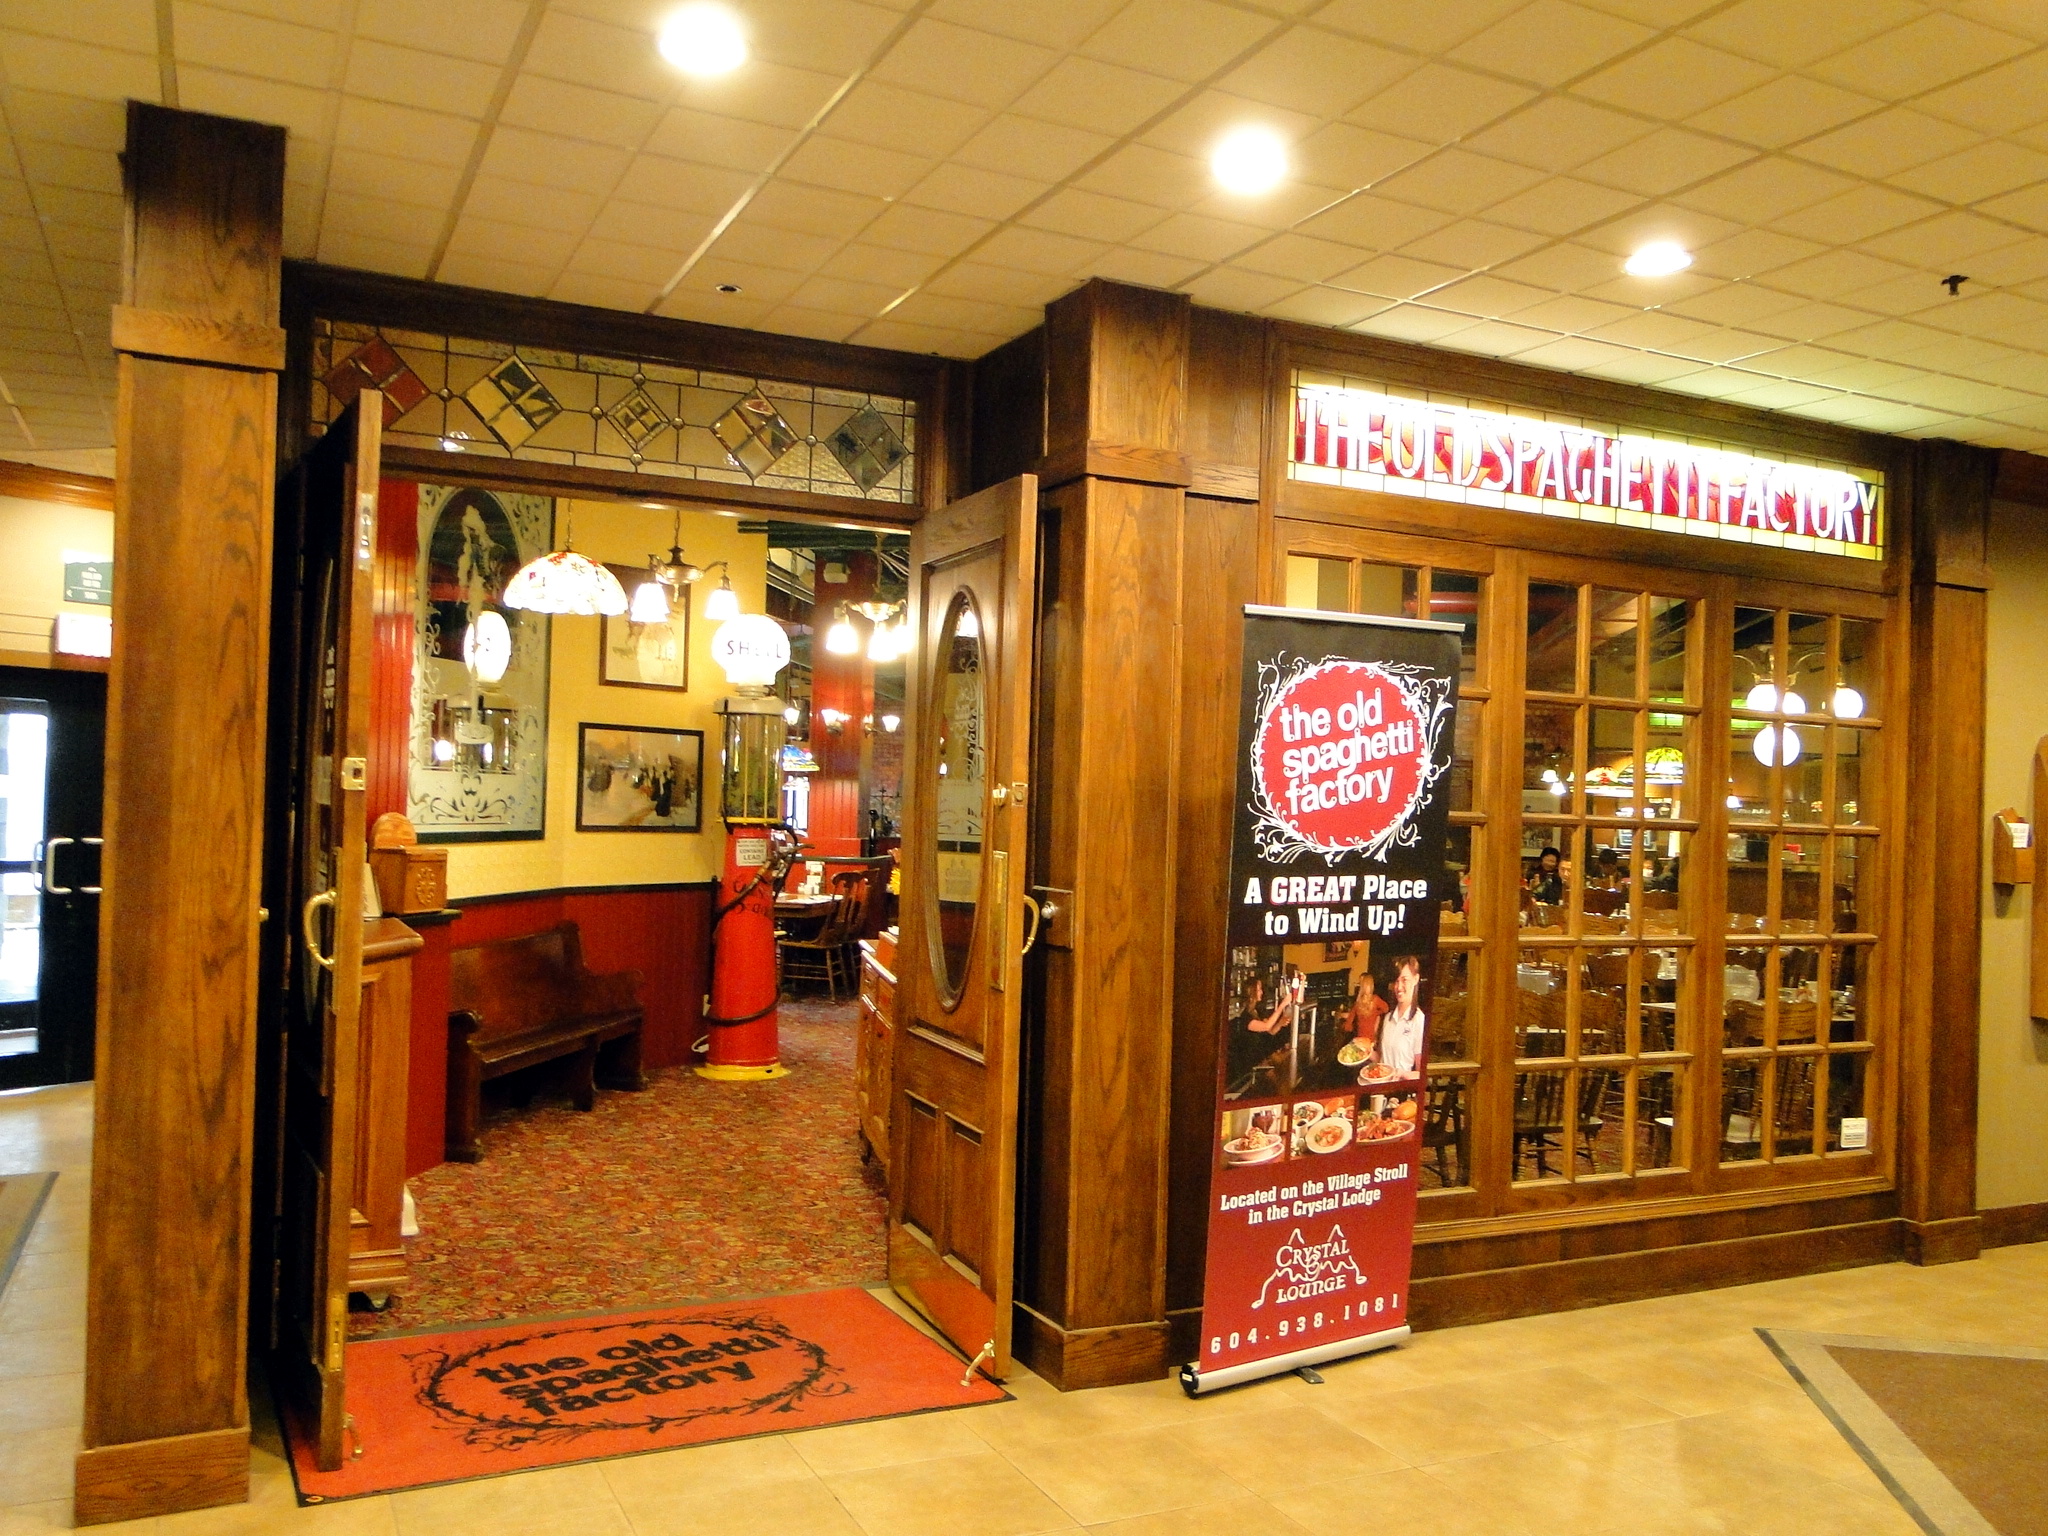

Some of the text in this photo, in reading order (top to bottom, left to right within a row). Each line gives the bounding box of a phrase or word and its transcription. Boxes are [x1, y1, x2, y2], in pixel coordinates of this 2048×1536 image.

[1293, 388, 1879, 545] THE OLD SPAGHETTI FACTORY
[1279, 687, 1383, 743] the old
[1282, 719, 1415, 784] spaghetti
[1285, 766, 1394, 816] factory
[1243, 875, 1428, 905] A GREAT Place
[1264, 904, 1405, 936] to Wind Up!
[1220, 1163, 1409, 1211] Located on the Village Stroll
[1248, 1188, 1381, 1225] in the Crystal Lodge
[1276, 1239, 1350, 1268] CRYSTAL
[1276, 1275, 1347, 1304] LOUNGE
[474, 1332, 695, 1384] the old
[500, 1334, 783, 1400] spaghetti
[523, 1360, 756, 1417] factory
